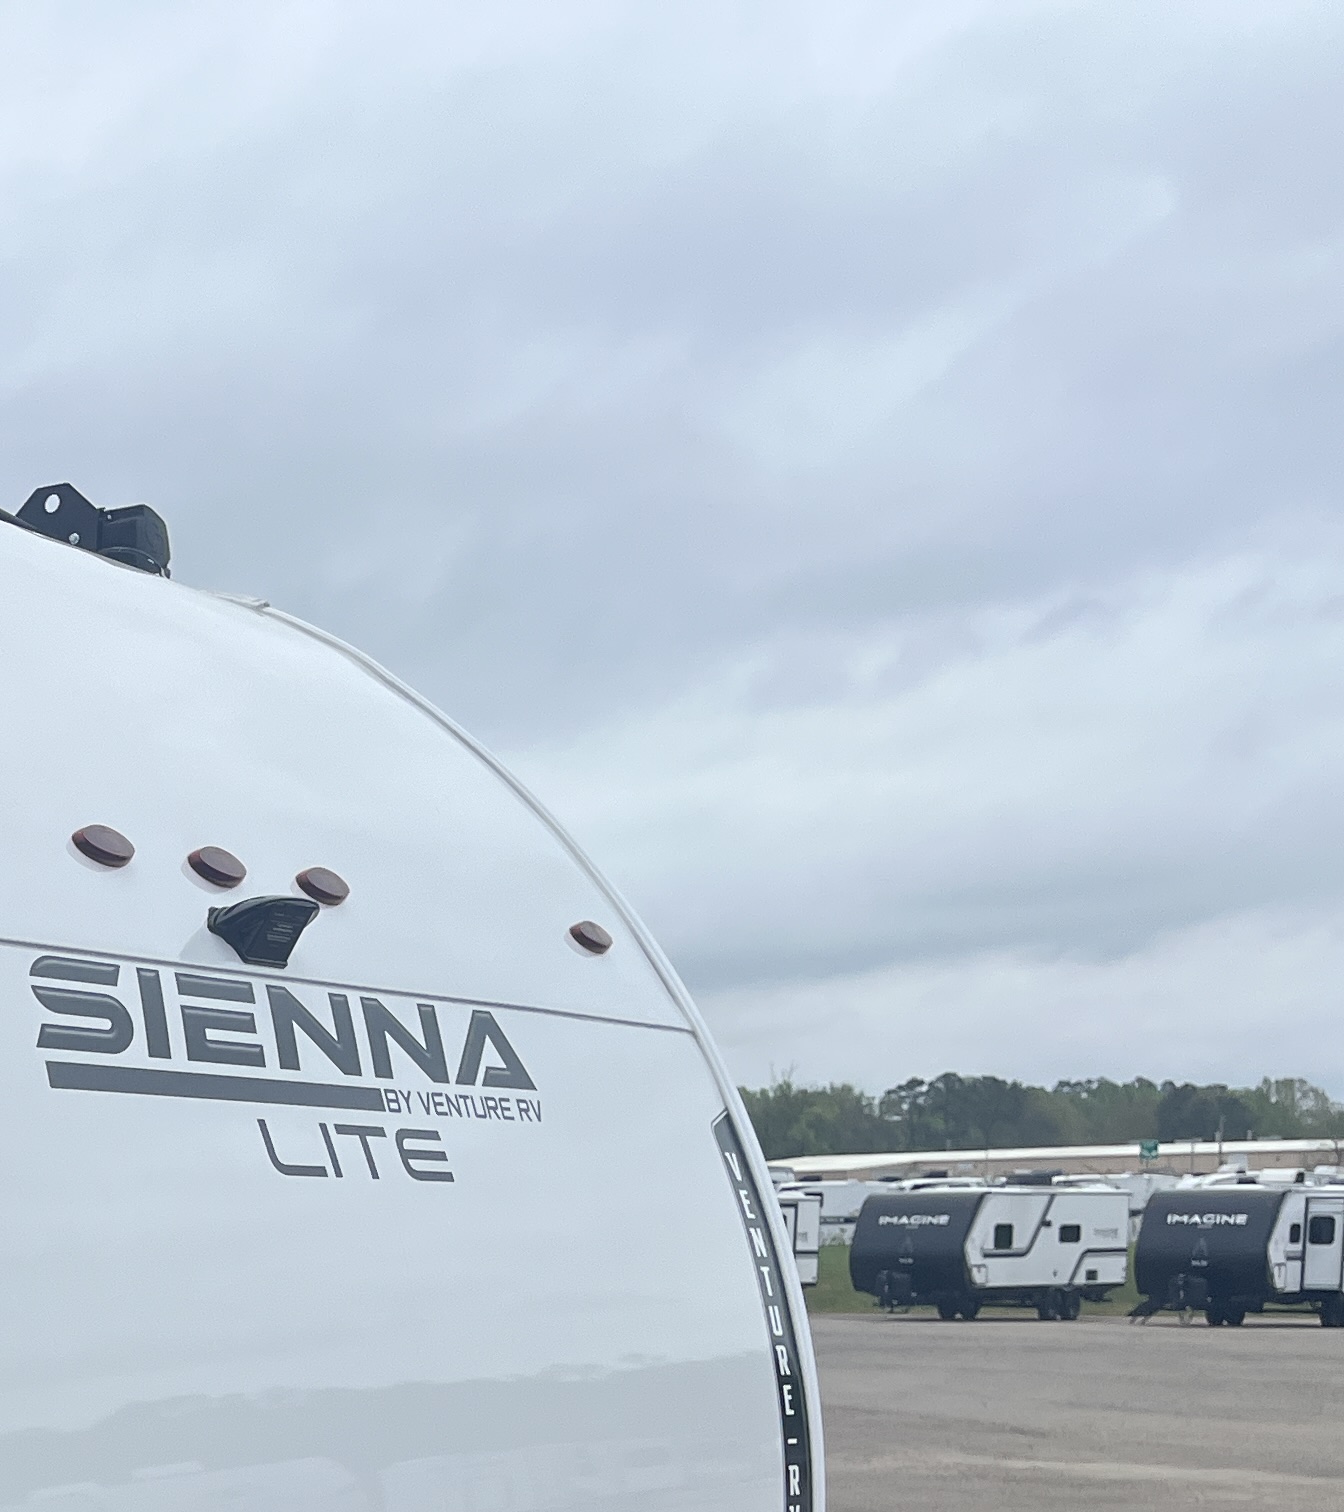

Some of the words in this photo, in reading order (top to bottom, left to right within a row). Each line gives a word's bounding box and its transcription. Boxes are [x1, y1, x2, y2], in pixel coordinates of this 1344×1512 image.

[29, 954, 538, 1091] SIENNA
[384, 1087, 413, 1115] BY
[416, 1091, 512, 1121] VENTURE
[515, 1099, 543, 1123] RV
[257, 1118, 455, 1183] LITE
[878, 1214, 951, 1226] IMAGINE
[1166, 1213, 1249, 1226] IMAGINE
